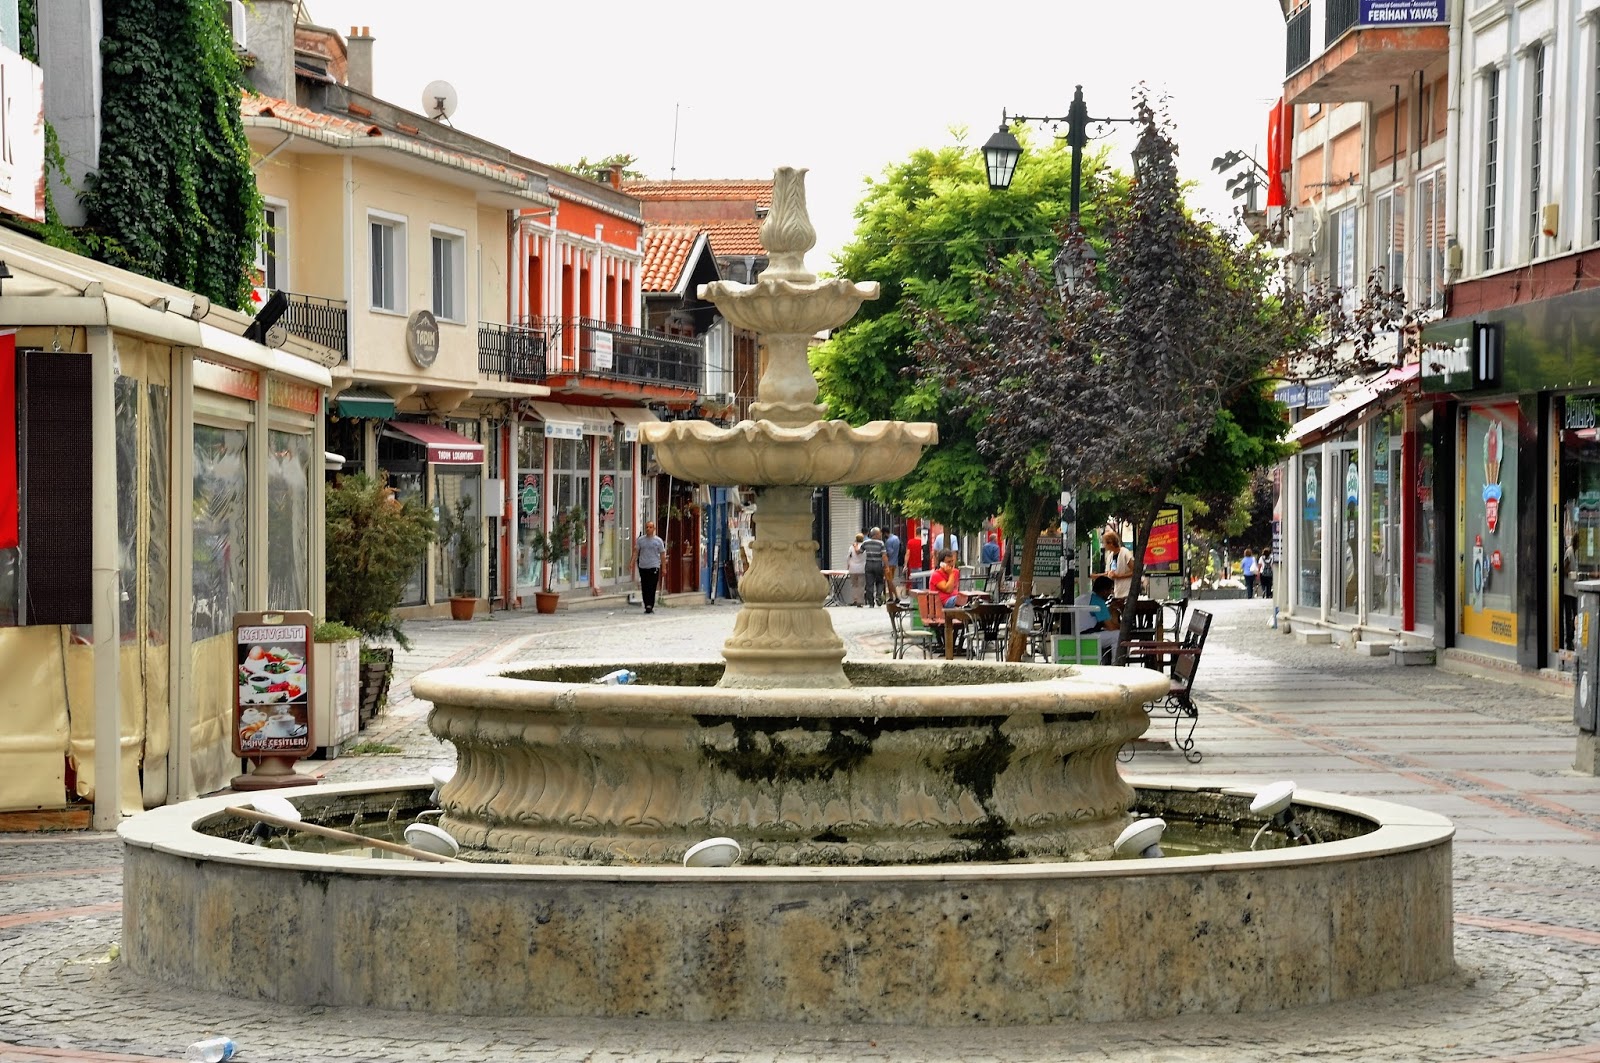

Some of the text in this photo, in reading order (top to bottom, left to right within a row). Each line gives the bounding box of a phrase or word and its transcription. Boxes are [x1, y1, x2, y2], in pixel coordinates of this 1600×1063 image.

[1368, 8, 1438, 21] FERİHAN YAVAŞ
[416, 329, 435, 346] TADIM
[241, 627, 304, 640] KAHVALTI
[268, 737, 307, 747] ÇEŞİTLERİ
